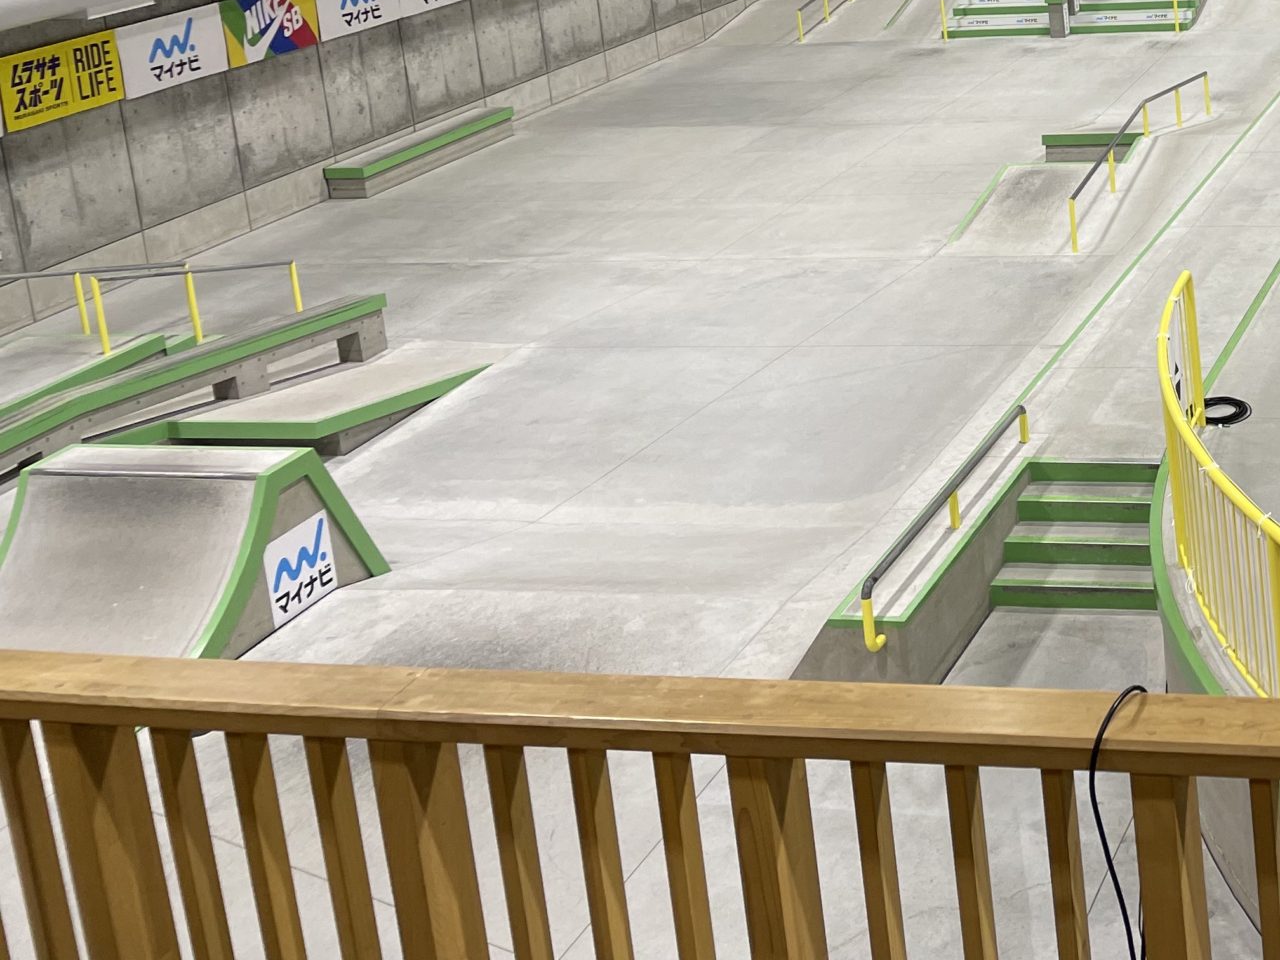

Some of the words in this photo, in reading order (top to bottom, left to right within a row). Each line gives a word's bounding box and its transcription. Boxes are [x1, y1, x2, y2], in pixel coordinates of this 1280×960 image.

[282, 5, 303, 37] SB
[341, 5, 382, 27] マイナビ
[11, 54, 60, 88] ムラサキ
[73, 40, 112, 74] RIDE
[151, 55, 201, 82] マイナビ
[14, 77, 64, 113] スポーツ
[77, 67, 116, 100] LIFE
[275, 564, 333, 614] マイナビ
